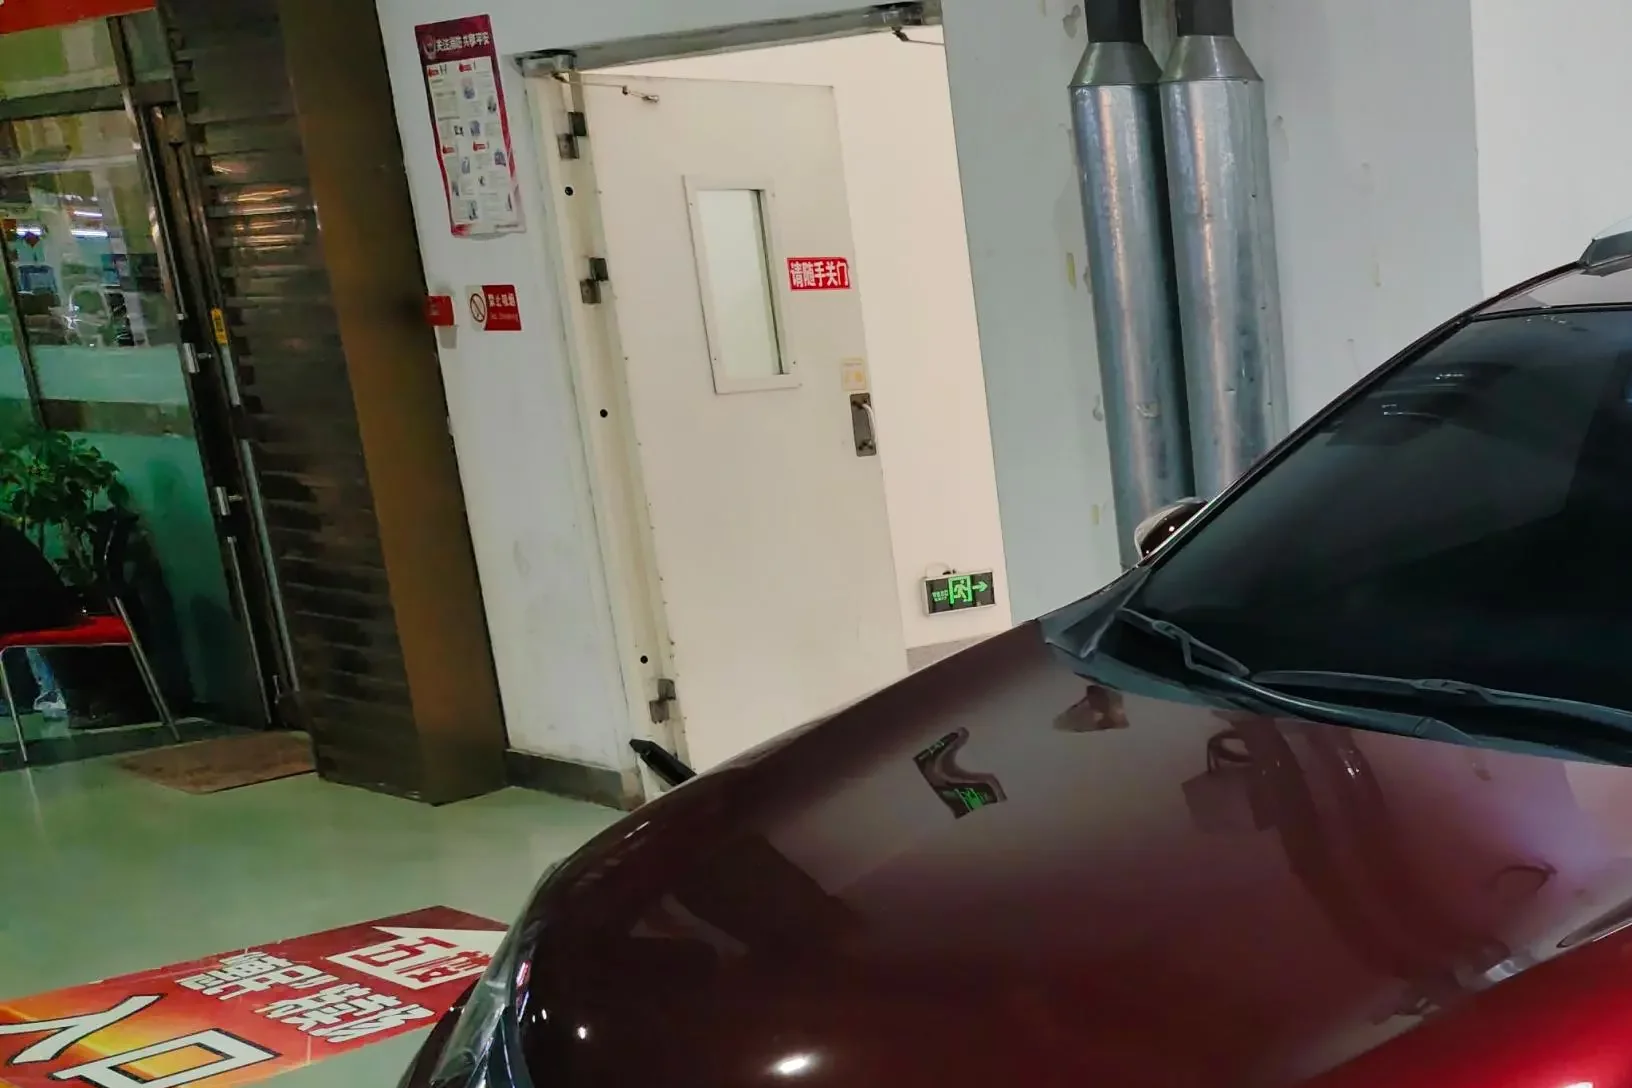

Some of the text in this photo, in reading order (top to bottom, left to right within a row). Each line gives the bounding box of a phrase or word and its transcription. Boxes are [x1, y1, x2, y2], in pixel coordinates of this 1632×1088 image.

[790, 260, 849, 288] 请随手关门
[348, 936, 492, 983] 五楼
